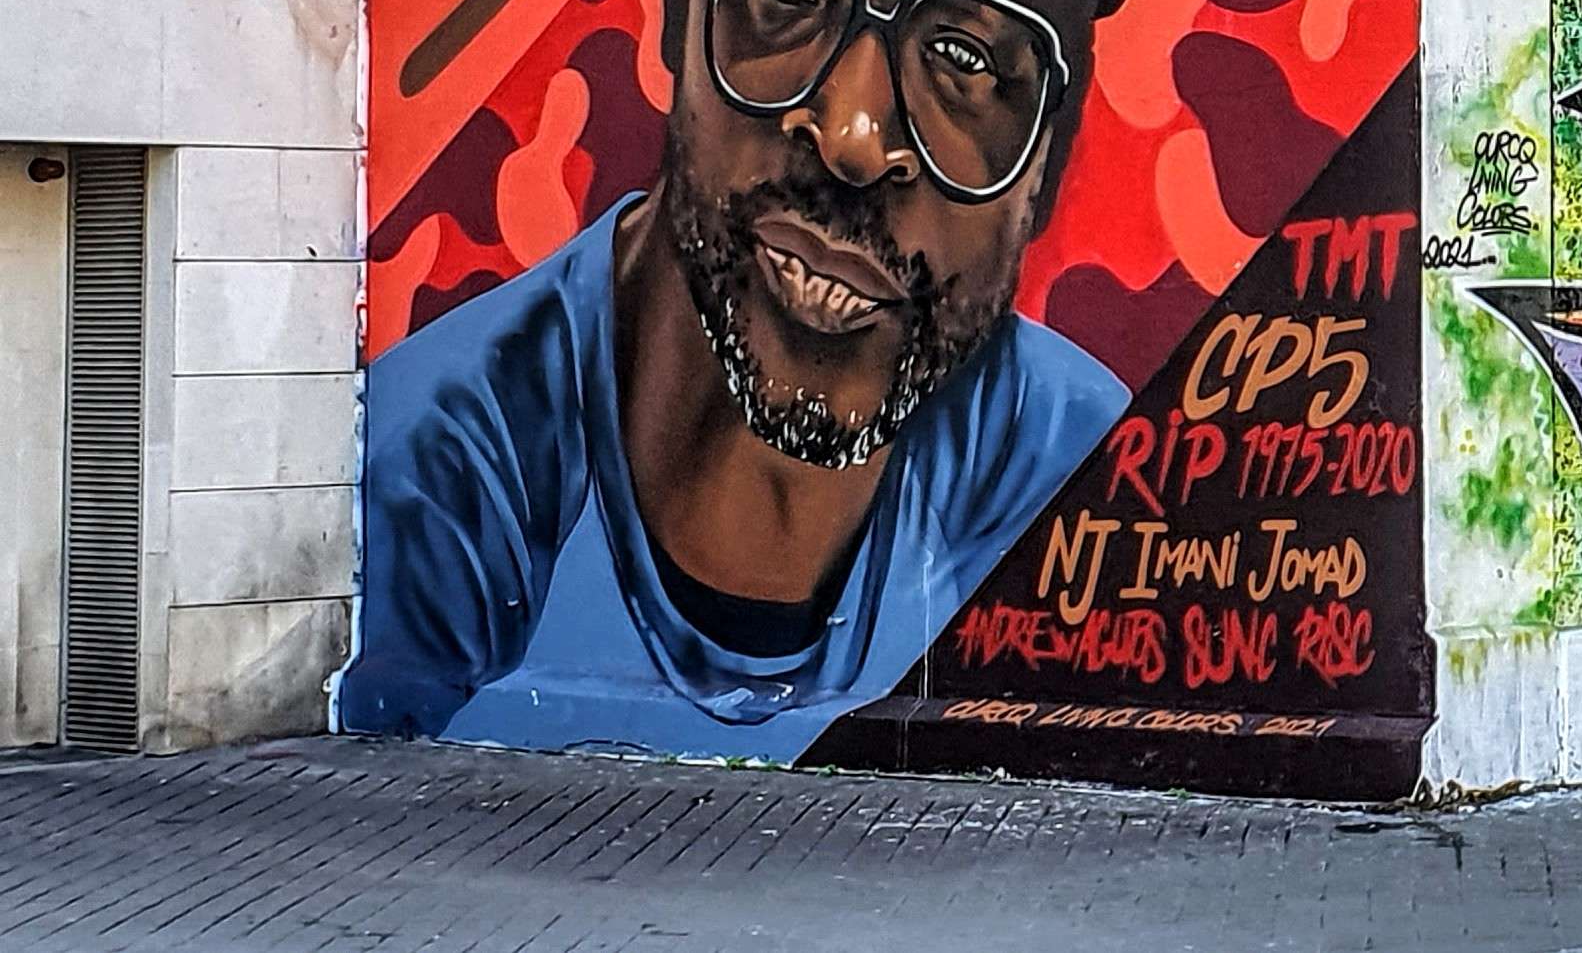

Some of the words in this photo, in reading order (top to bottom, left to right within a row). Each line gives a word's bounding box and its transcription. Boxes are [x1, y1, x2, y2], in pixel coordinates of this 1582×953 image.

[1283, 211, 1417, 300] TMT
[1182, 313, 1370, 429] CP5
[1240, 422, 1416, 499] 1975-2020
[1038, 509, 1121, 626] NJ
